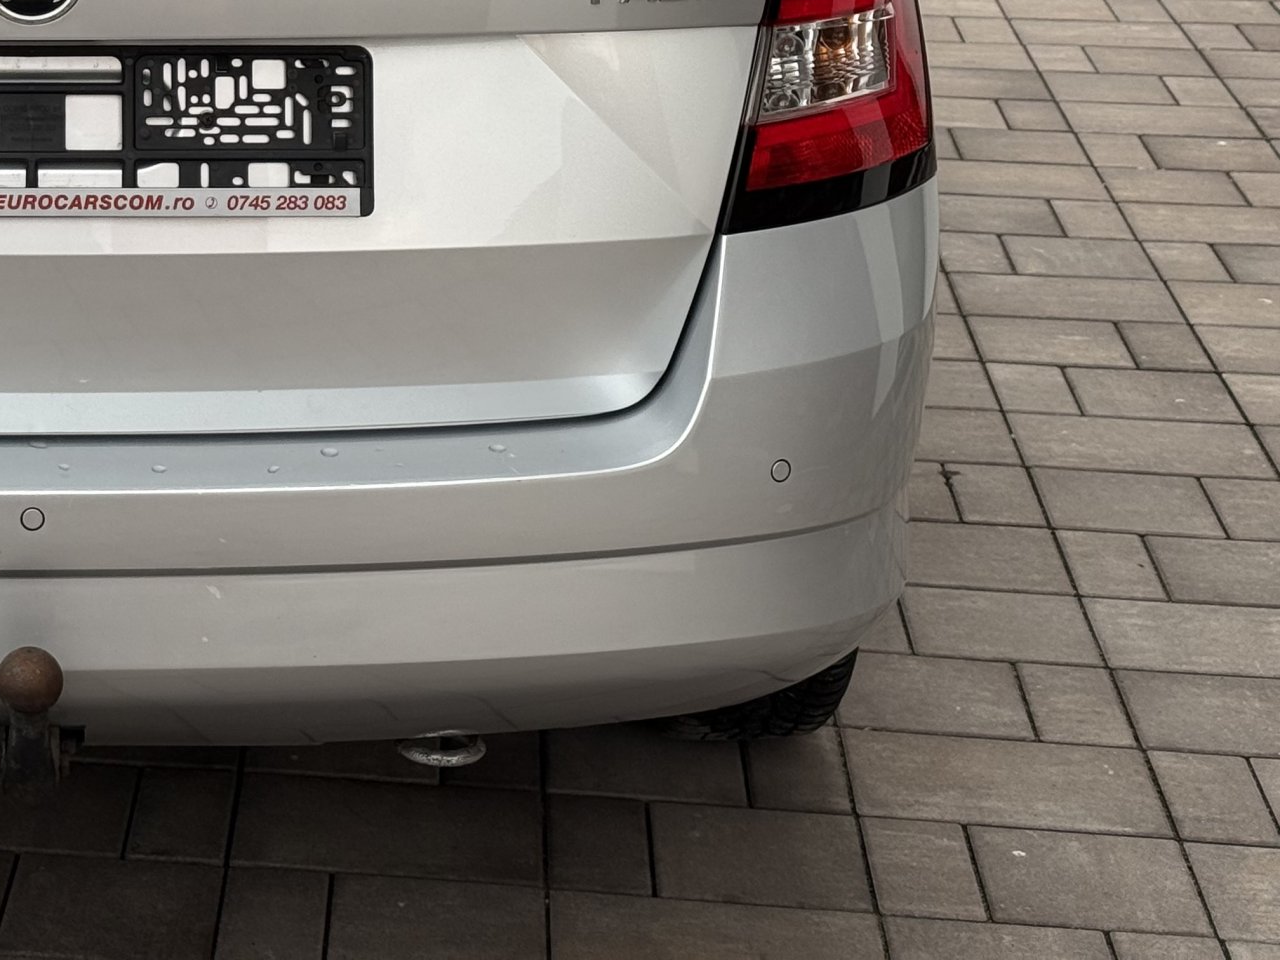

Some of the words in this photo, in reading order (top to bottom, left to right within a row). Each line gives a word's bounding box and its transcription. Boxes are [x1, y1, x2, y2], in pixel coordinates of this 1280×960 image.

[227, 194, 271, 211] 0745
[275, 194, 309, 211] 283
[313, 194, 347, 211] 083
